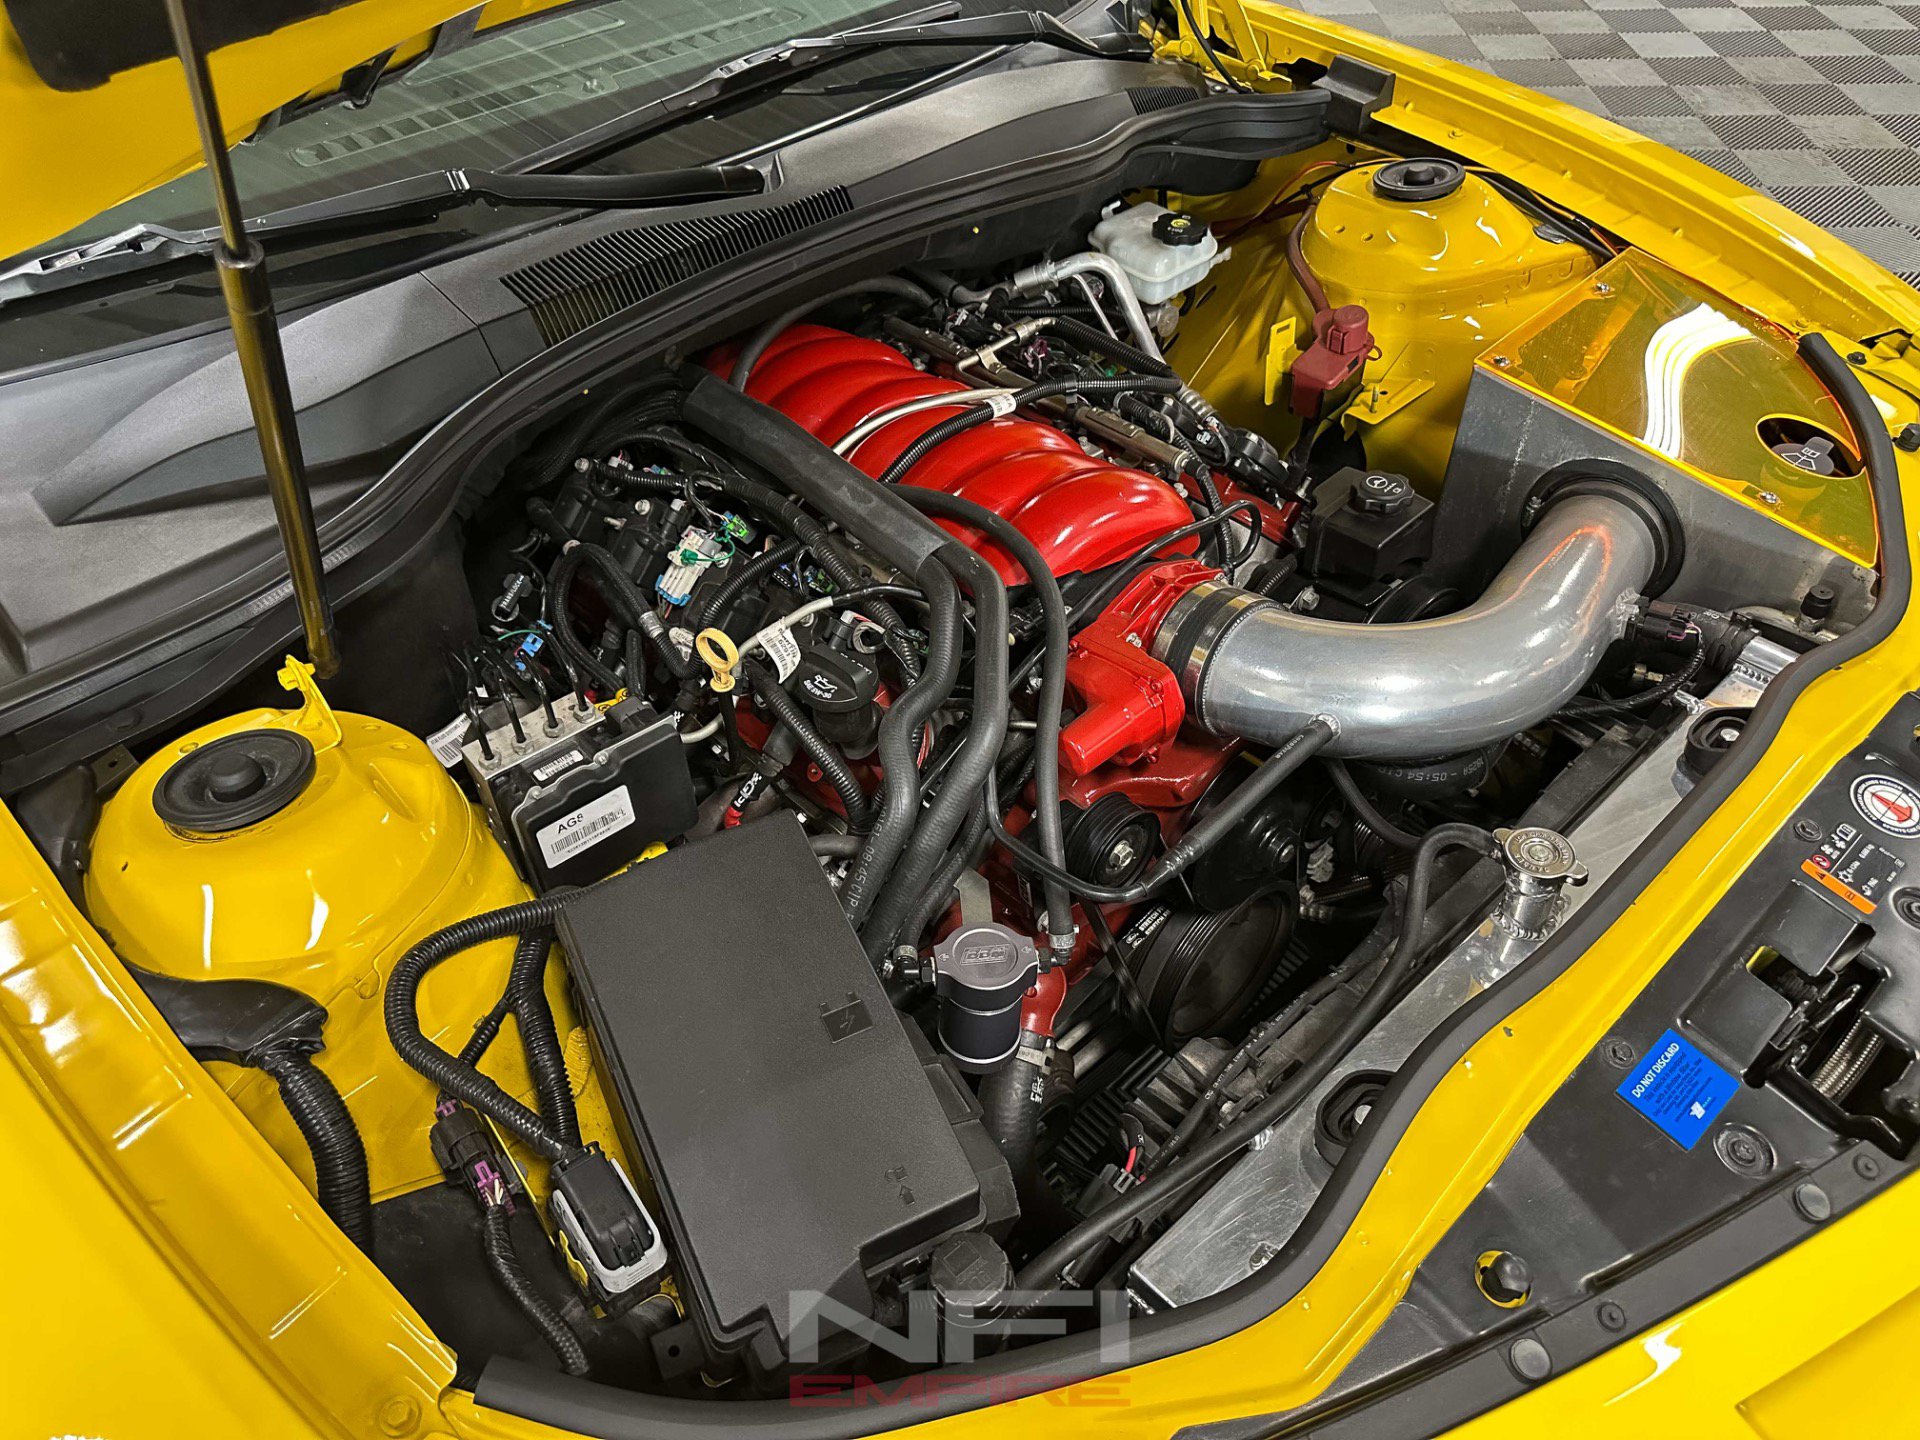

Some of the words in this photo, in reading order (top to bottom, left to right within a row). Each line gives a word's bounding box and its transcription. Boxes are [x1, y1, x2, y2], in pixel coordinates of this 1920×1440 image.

[1408, 772, 1448, 782] 05:54
[1138, 910, 1160, 932] STRETCH
[1632, 1085, 1645, 1098] DO
[1641, 1071, 1657, 1087] NOT
[1652, 1042, 1680, 1072] DISCARD
